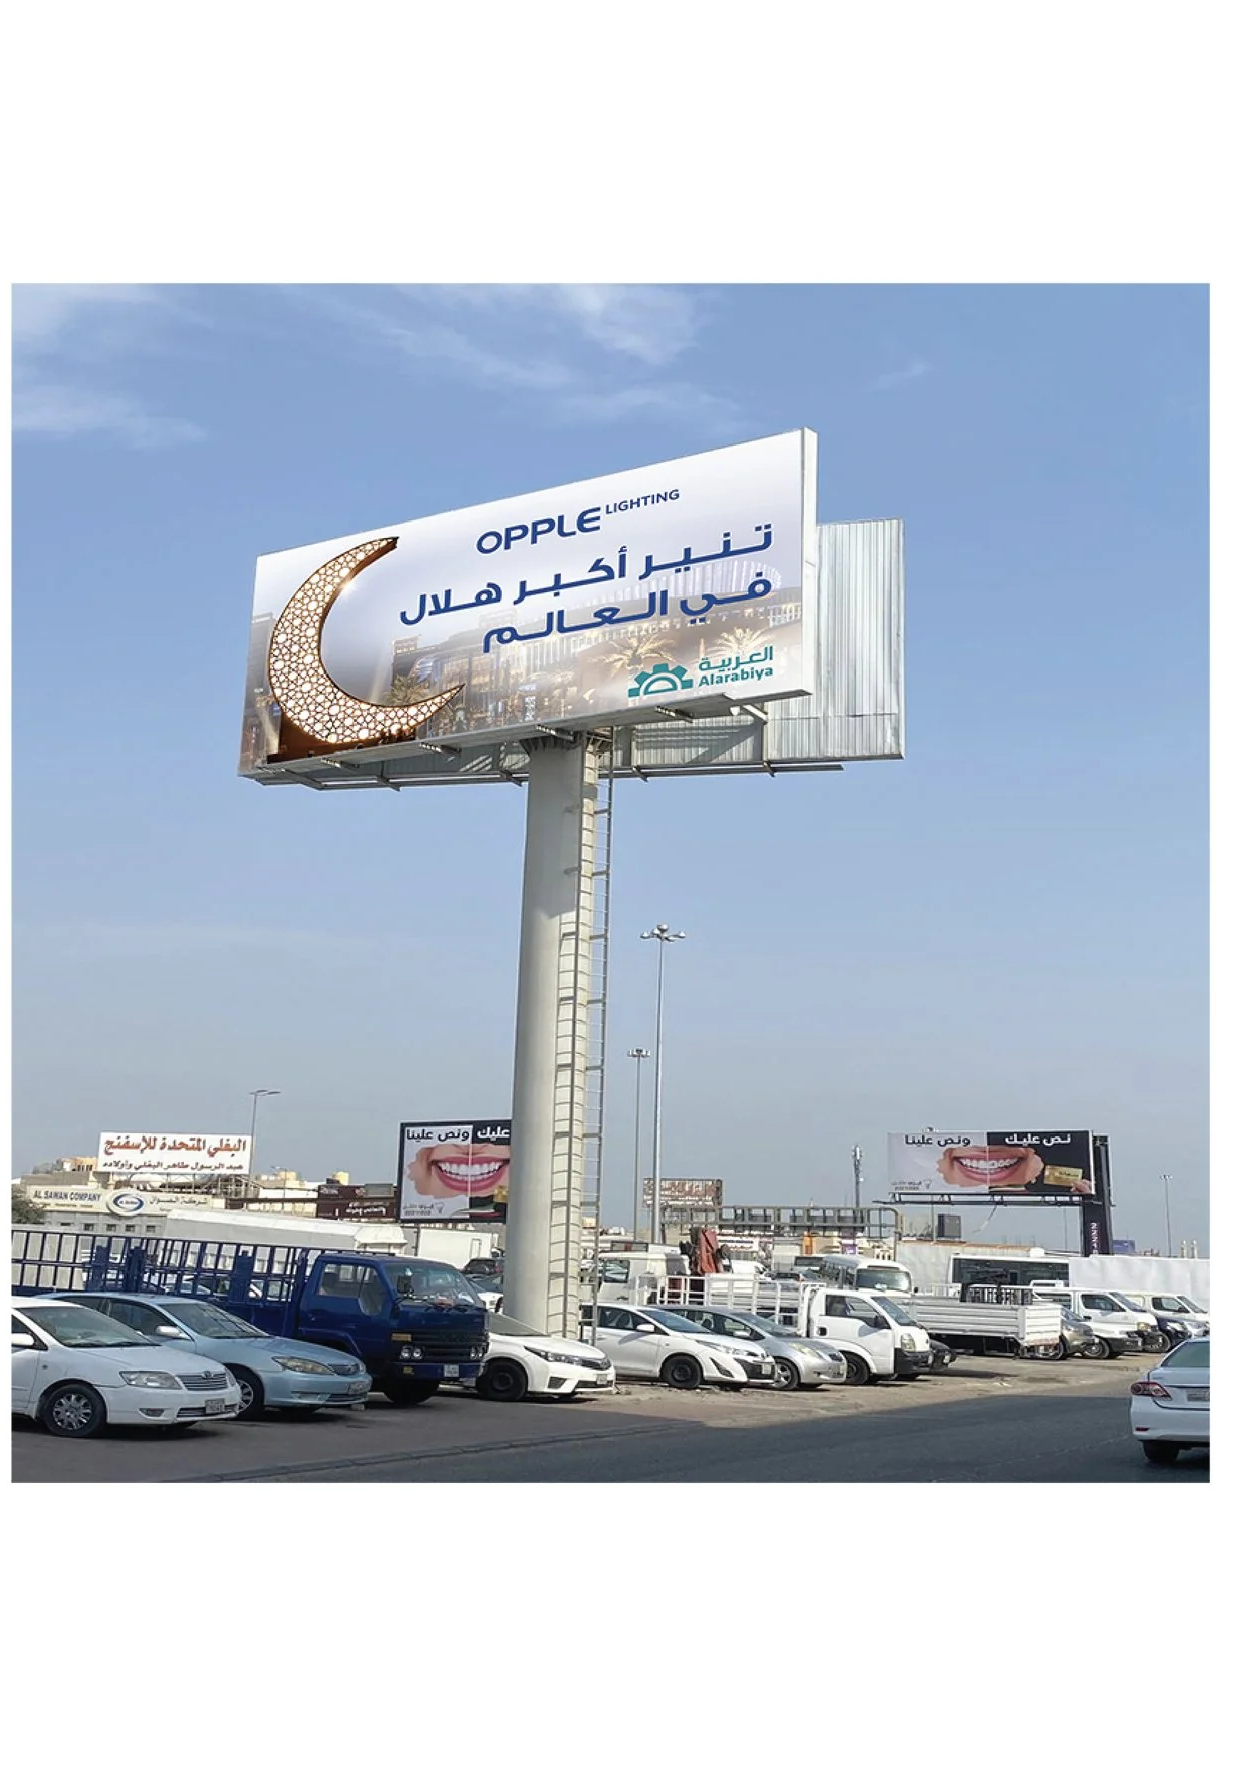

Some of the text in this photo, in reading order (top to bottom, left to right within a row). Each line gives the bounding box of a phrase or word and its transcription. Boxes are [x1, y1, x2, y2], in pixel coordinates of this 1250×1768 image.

[476, 488, 681, 555] OPPLE LIGHTING
[399, 523, 773, 626] تنير أكبر هلال
[482, 571, 773, 654] في العالم
[699, 645, 774, 672] العربية
[699, 666, 774, 687] Alarabiya
[904, 1134, 933, 1146] علينا
[1005, 1133, 1041, 1146] عليك
[33, 1190, 42, 1199] AL
[69, 1191, 101, 1201] COMPANY
